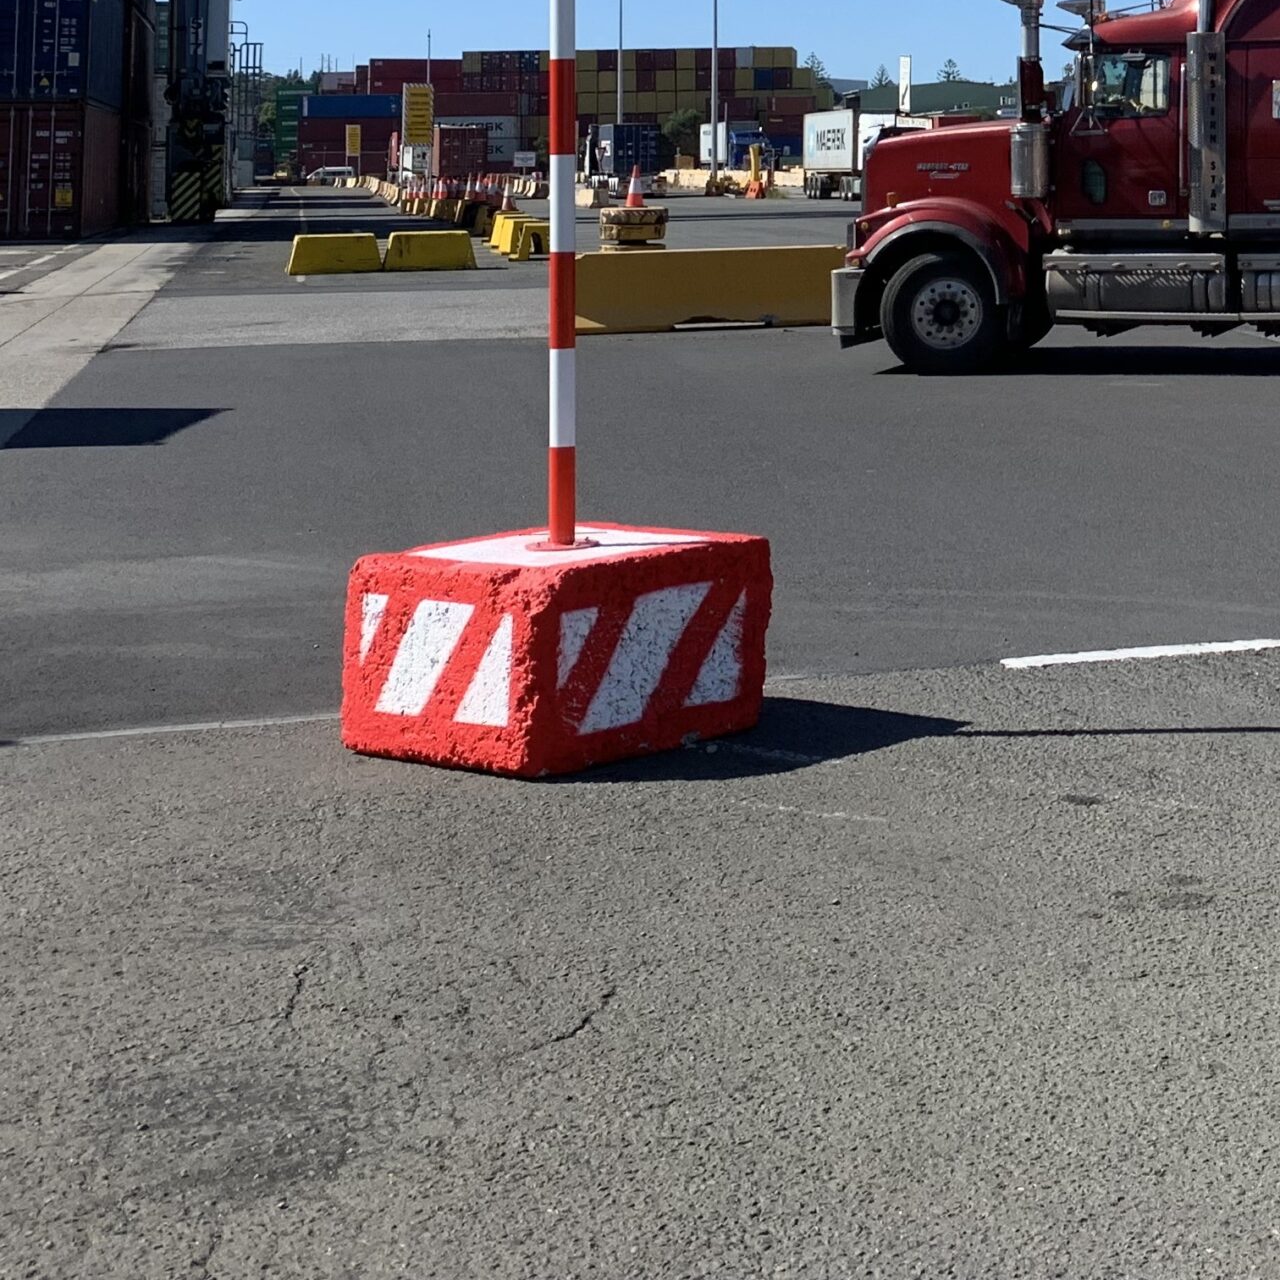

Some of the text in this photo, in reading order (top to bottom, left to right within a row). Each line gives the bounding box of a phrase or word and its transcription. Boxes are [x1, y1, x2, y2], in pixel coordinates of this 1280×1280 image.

[816, 127, 846, 151] MAERSK
[1208, 52, 1217, 211] WESTERN STAR
